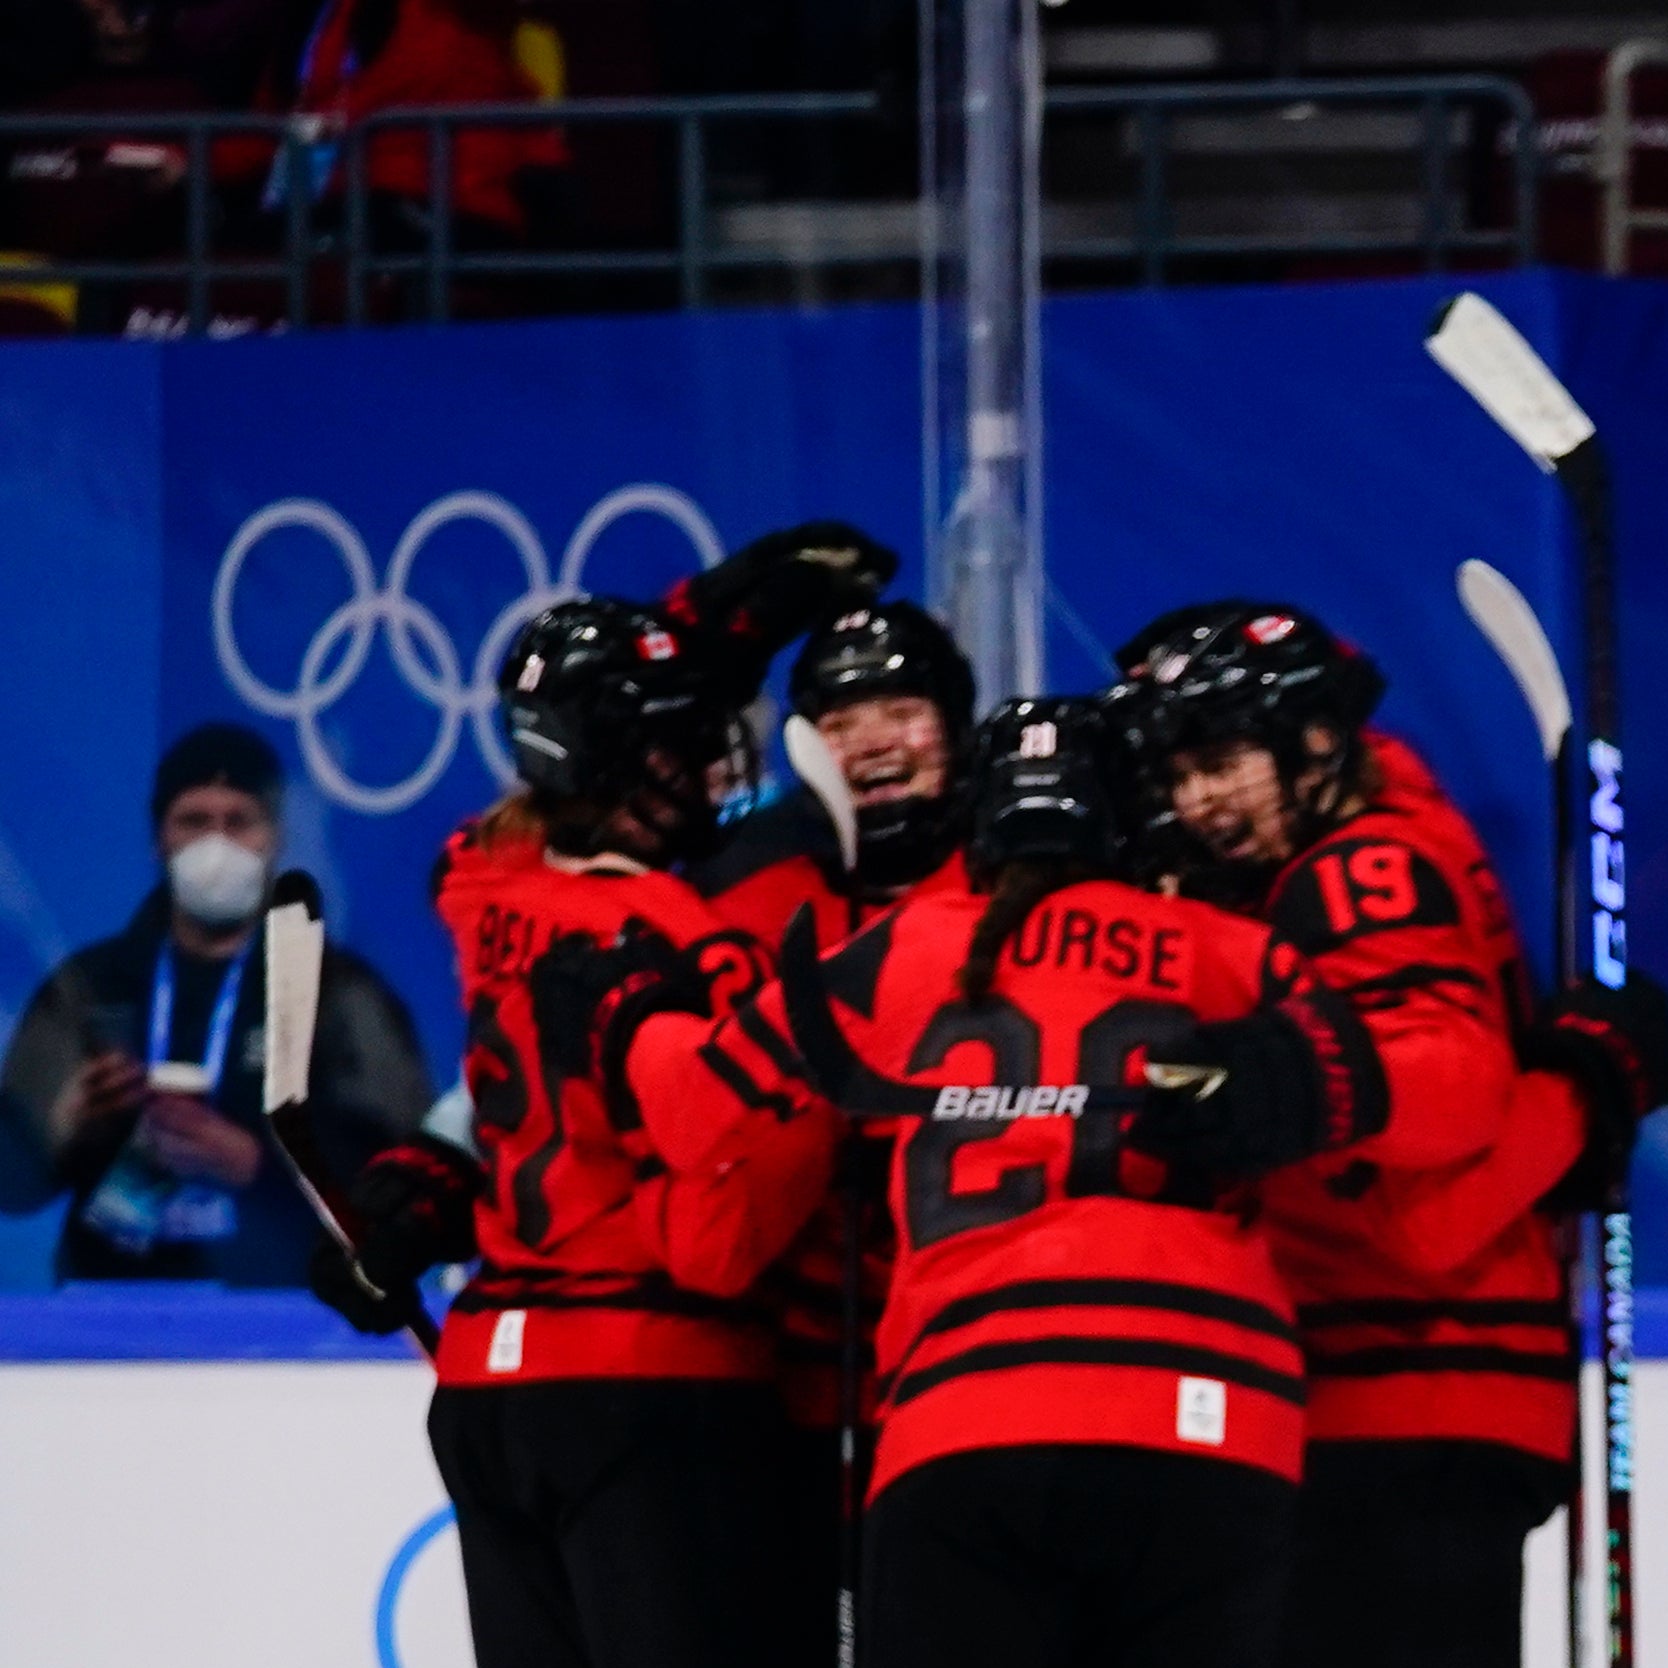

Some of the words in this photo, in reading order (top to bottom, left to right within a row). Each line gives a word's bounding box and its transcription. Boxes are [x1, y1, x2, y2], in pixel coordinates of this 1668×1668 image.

[1312, 843, 1418, 934] 19
[1588, 738, 1626, 990] CCM
[1010, 906, 1184, 990] URSE
